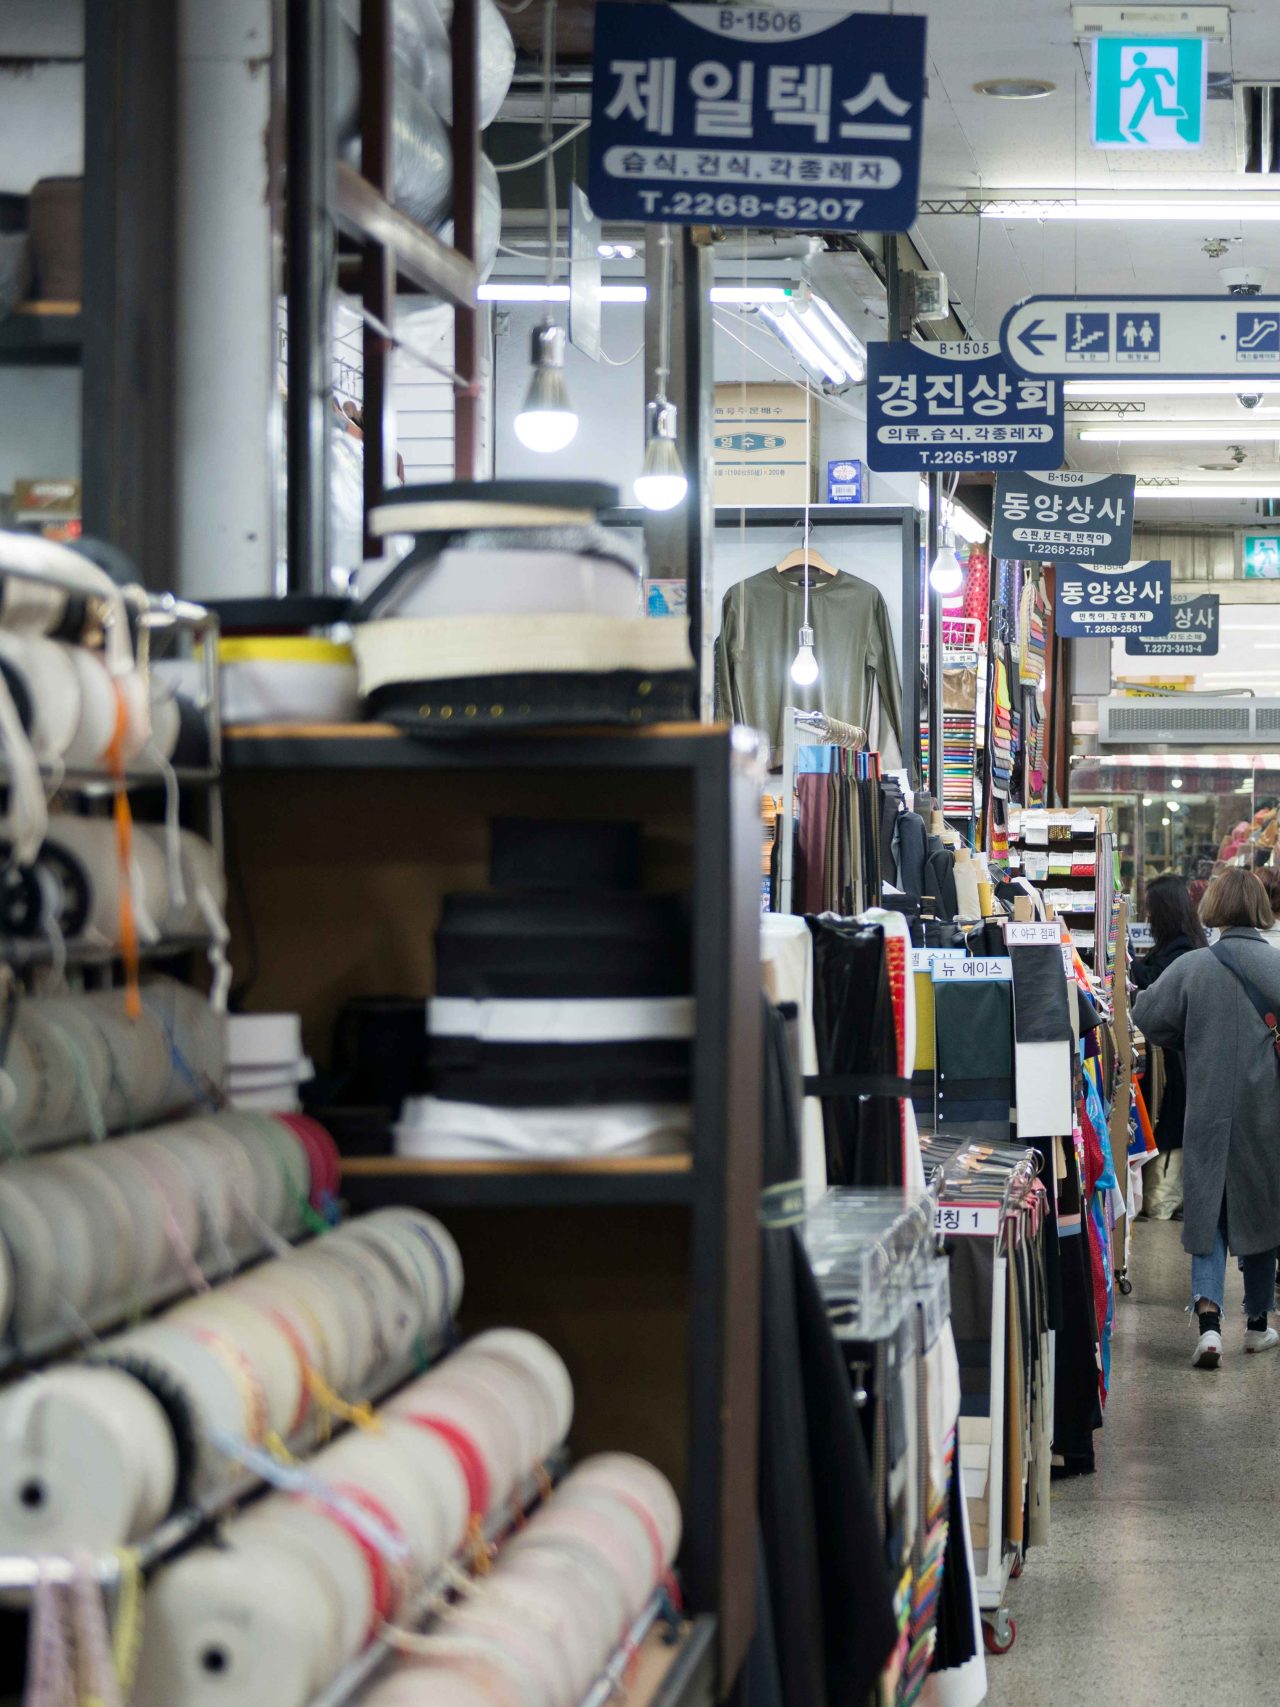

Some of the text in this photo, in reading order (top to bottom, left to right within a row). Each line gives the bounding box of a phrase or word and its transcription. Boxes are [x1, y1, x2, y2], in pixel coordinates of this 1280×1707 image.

[719, 10, 801, 32] B-1506
[604, 57, 912, 143] 제일텍스
[638, 190, 863, 222] T.2268-5207
[939, 343, 990, 355] B-1505
[888, 427, 1043, 441] 의류.습식.각종레자
[919, 451, 1017, 464] T.2265-1897
[1048, 473, 1084, 483] B-1504
[1001, 492, 1125, 527] 동양상사
[1028, 544, 1095, 556] T.2268-2581
[1061, 581, 1163, 605] 동양상사
[1174, 608, 1214, 629] 상사
[942, 961, 1002, 976] 뉴 에이스
[972, 1212, 978, 1228] 1
